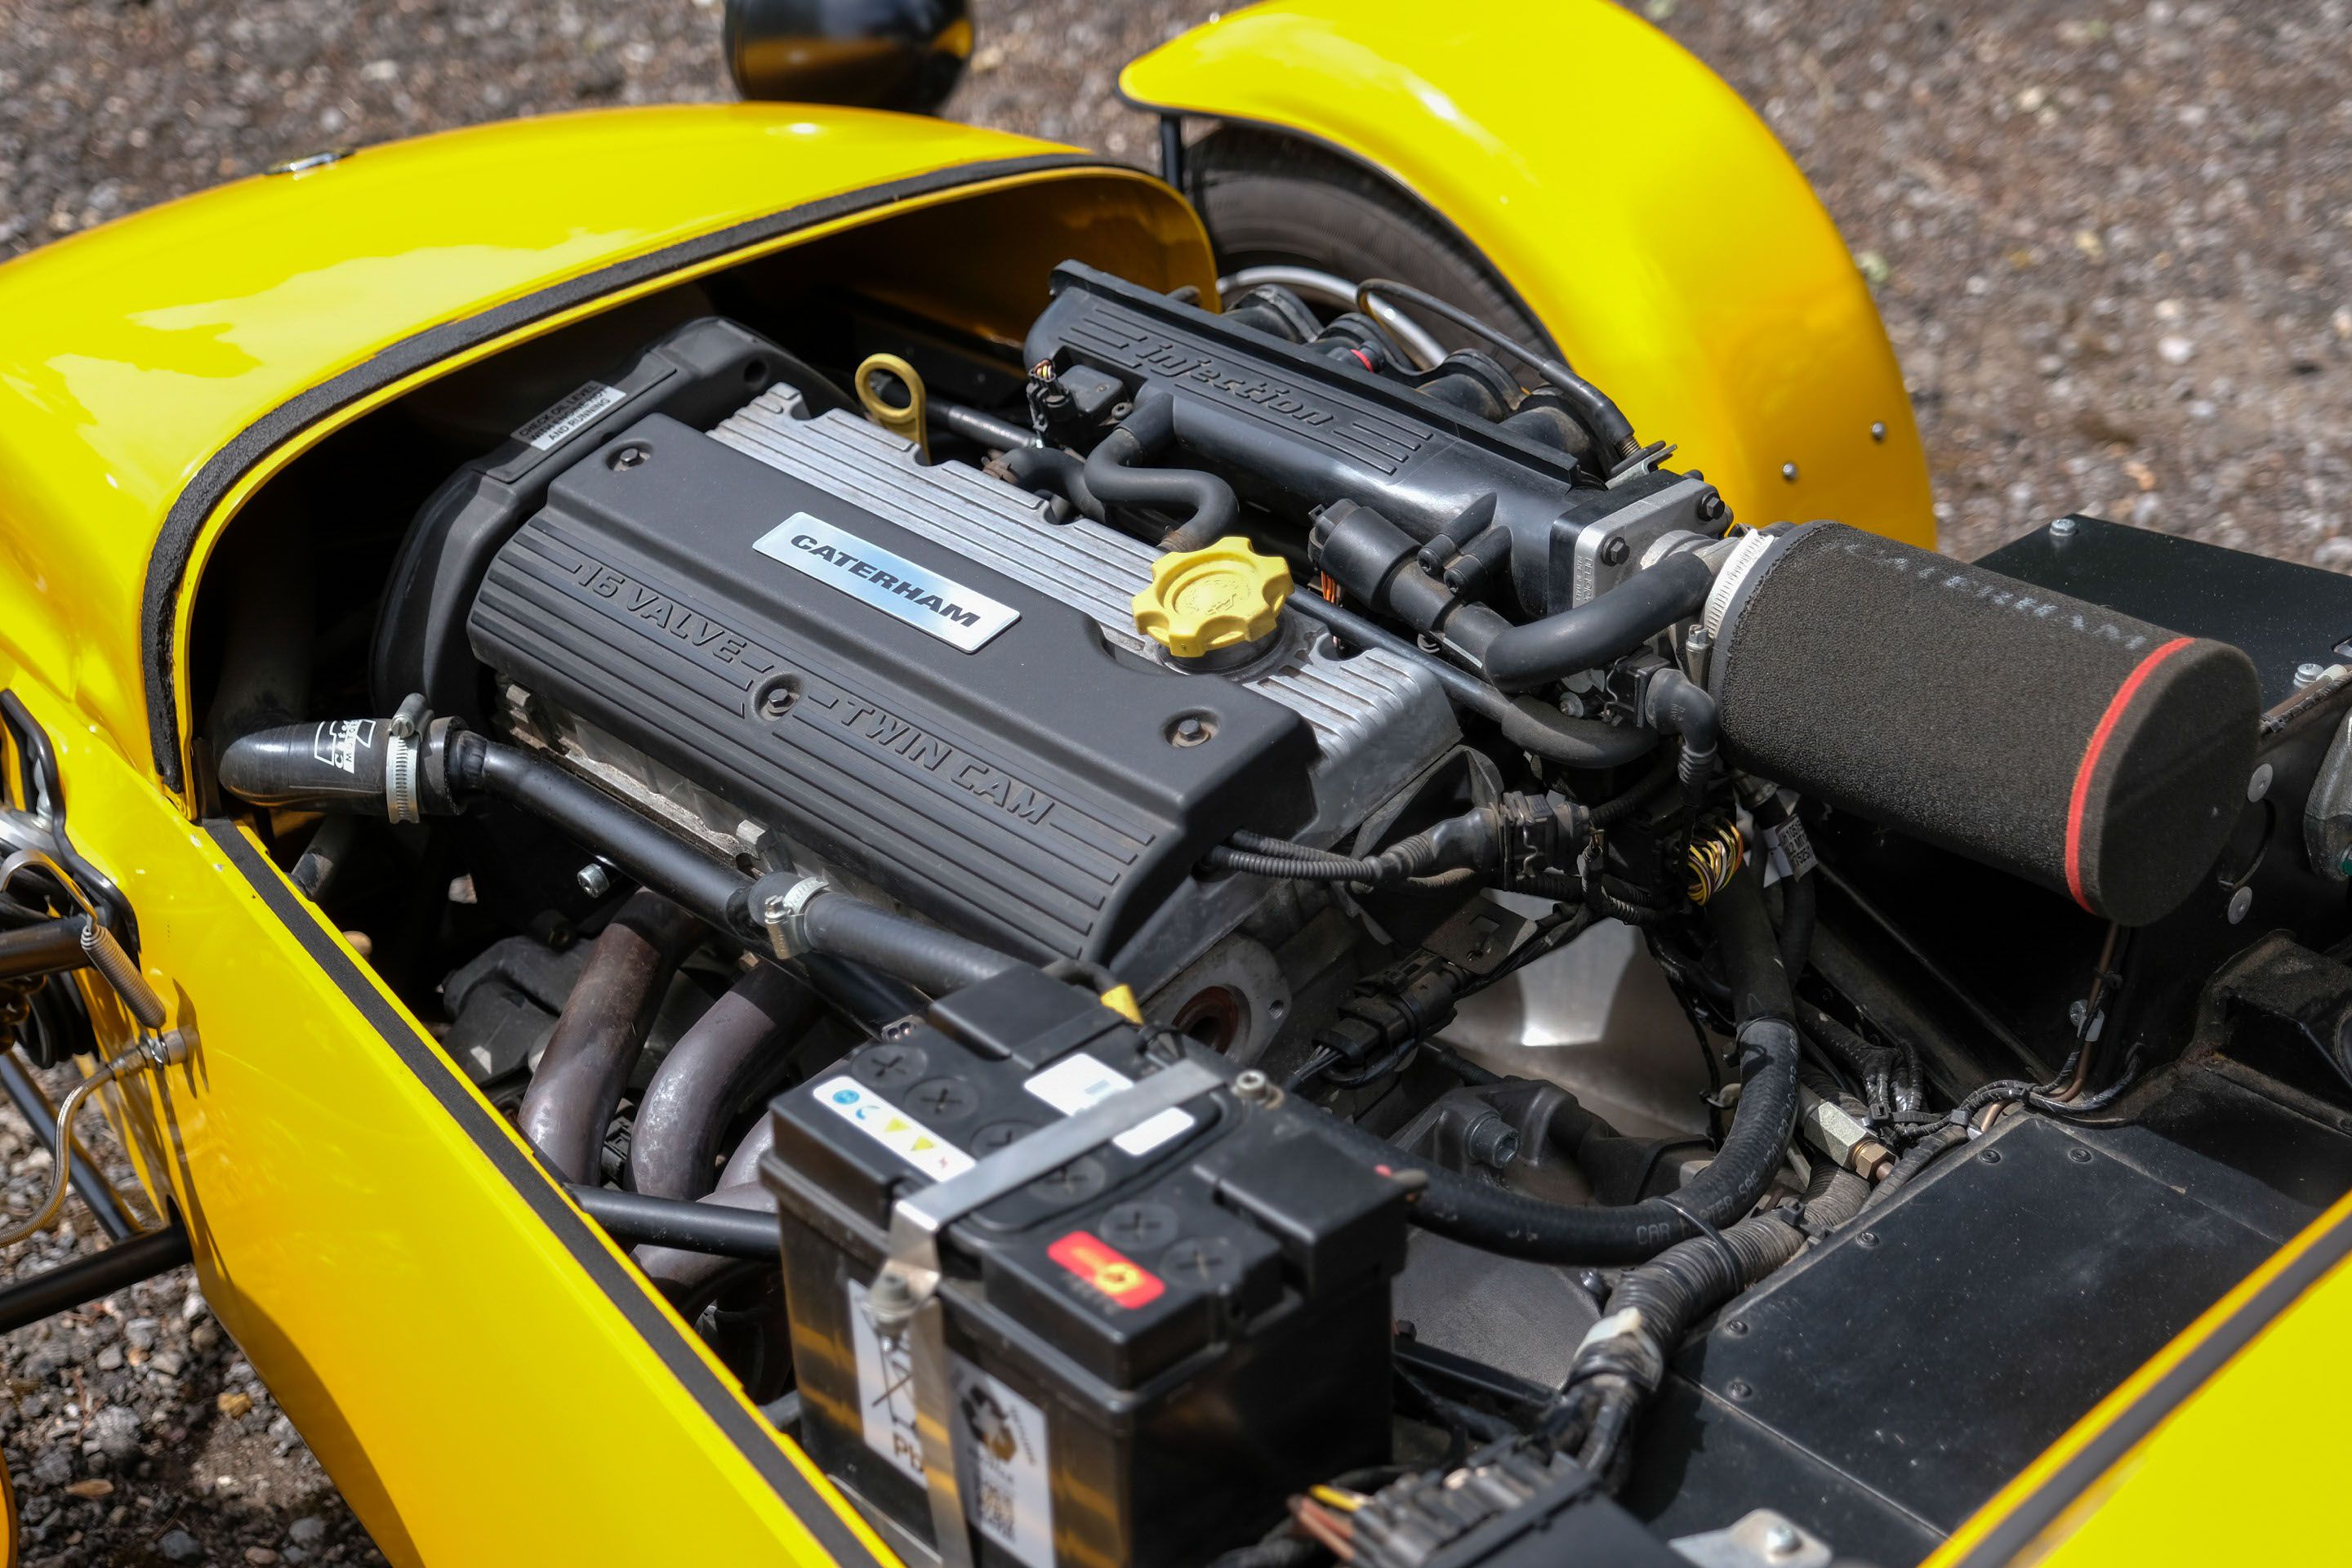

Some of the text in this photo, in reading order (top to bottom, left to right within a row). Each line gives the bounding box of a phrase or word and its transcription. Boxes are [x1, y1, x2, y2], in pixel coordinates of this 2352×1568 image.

[548, 397, 612, 441] AND RUNNING
[578, 566, 748, 663] 16 VALVE
[790, 534, 982, 628] CATERHAM
[840, 699, 1056, 826] TWIN CAM
[1636, 1222, 1671, 1245] CAR
